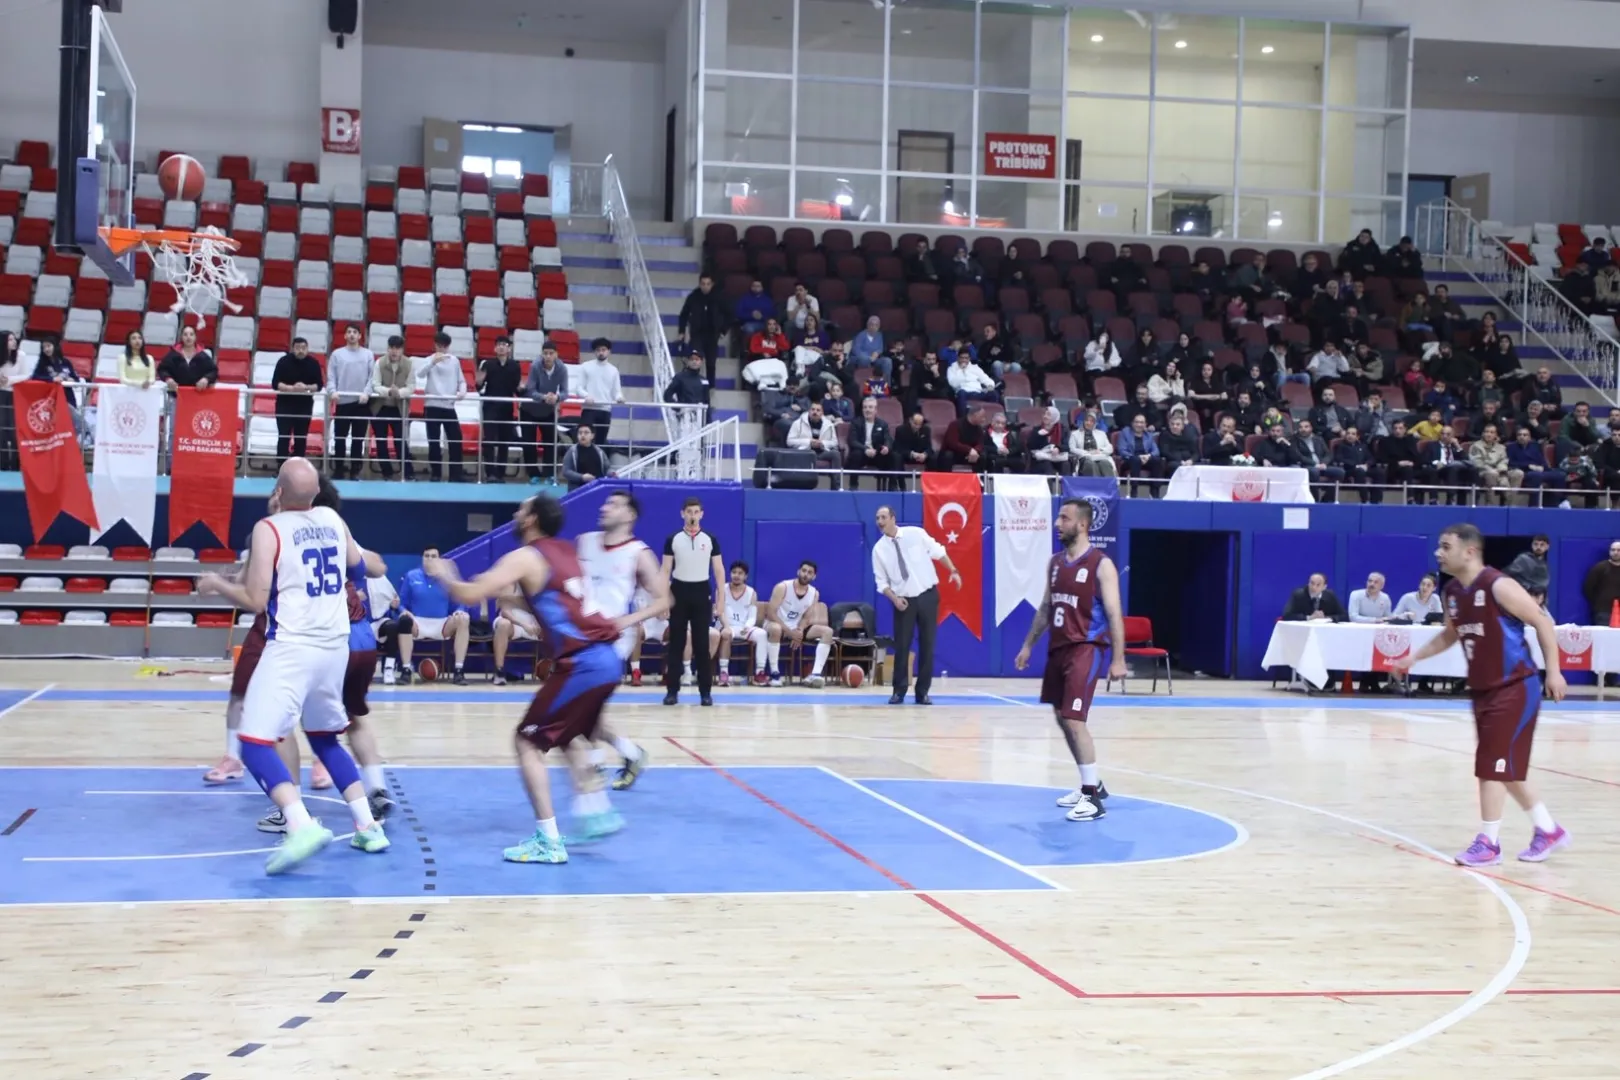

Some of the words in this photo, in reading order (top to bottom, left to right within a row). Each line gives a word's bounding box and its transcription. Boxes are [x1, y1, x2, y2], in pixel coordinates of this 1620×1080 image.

[329, 110, 353, 143] B
[989, 140, 1051, 156] PROTOKOL
[994, 154, 1047, 170] TRİBÜNÜ
[178, 445, 196, 453] SPOR
[196, 446, 232, 456] BAKANLIĞI
[191, 438, 222, 447] GENÇLİK
[222, 440, 232, 448] VE
[302, 546, 342, 598] 35
[1053, 606, 1065, 628] 6
